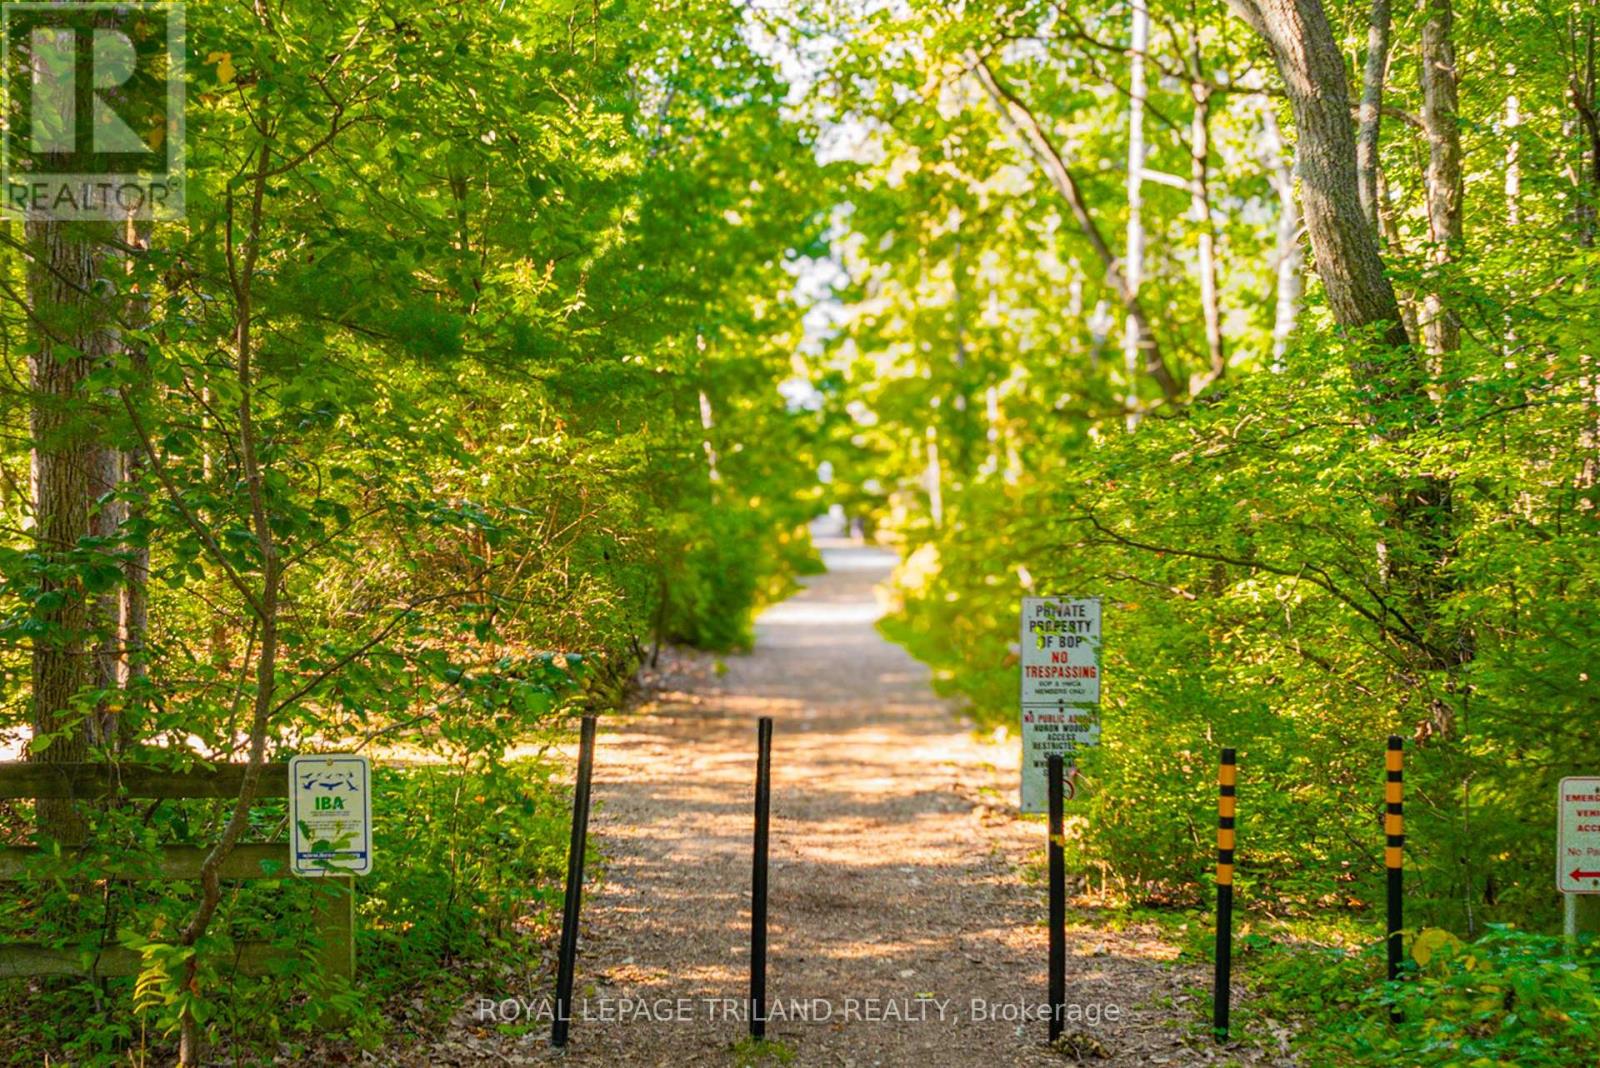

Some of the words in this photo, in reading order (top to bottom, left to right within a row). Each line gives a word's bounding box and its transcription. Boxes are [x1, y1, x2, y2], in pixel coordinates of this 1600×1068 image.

[1036, 604, 1086, 617] PRIVATE
[1029, 620, 1091, 632] PROPERTY
[1059, 636, 1082, 648] BOP
[1051, 651, 1068, 663] NO
[1025, 666, 1096, 678] TRESPASSING
[1024, 714, 1034, 723] NO
[1038, 714, 1065, 723] PUBLIC
[1033, 724, 1059, 732] HURON
[315, 796, 345, 810] IBA
[1568, 847, 1582, 856] No
